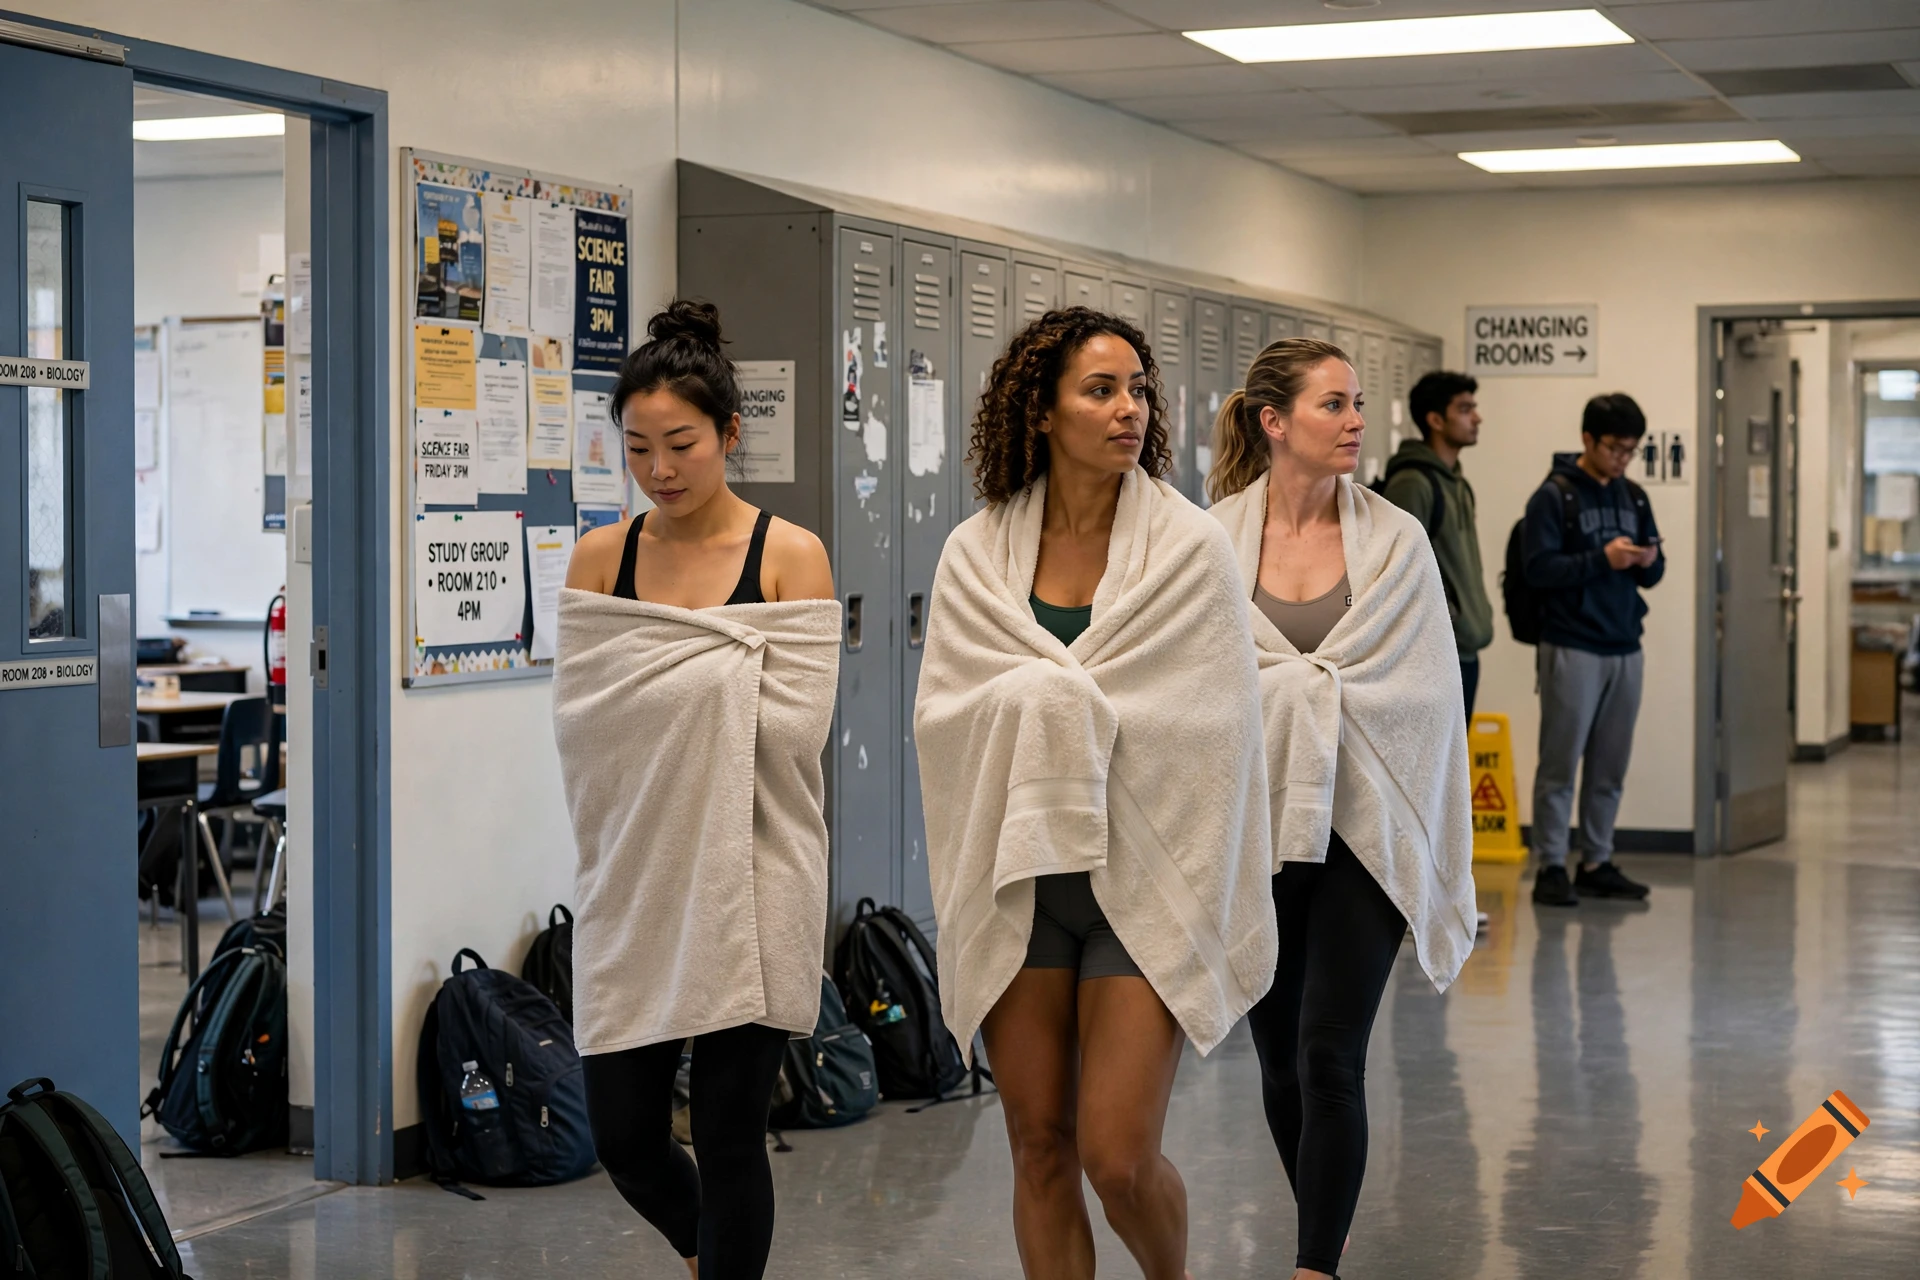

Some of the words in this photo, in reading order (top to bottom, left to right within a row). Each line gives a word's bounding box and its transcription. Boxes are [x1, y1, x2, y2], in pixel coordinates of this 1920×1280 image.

[577, 235, 625, 266] SCIENCE
[588, 268, 615, 295] FAIR
[589, 307, 614, 333] 3PM
[1475, 315, 1588, 340] CHANGING
[1475, 342, 1554, 366] ROOMS
[0, 363, 18, 378] OOM
[20, 365, 36, 379] 208
[46, 366, 85, 382] BIOLOGY
[743, 389, 785, 402] ANGING
[740, 405, 776, 418] OOMS
[453, 442, 470, 457] FAIR
[425, 464, 451, 478] FRIDAY
[453, 464, 468, 478] 3PM
[428, 542, 467, 563] STUDY
[470, 541, 509, 562] GROUP
[438, 571, 473, 592] ROOM
[476, 570, 497, 591] 210
[457, 600, 481, 621] 4PM
[2, 667, 29, 682] ROOM
[31, 666, 47, 680] 208
[56, 663, 94, 678] BIOLOGY
[1474, 752, 1499, 768] WET
